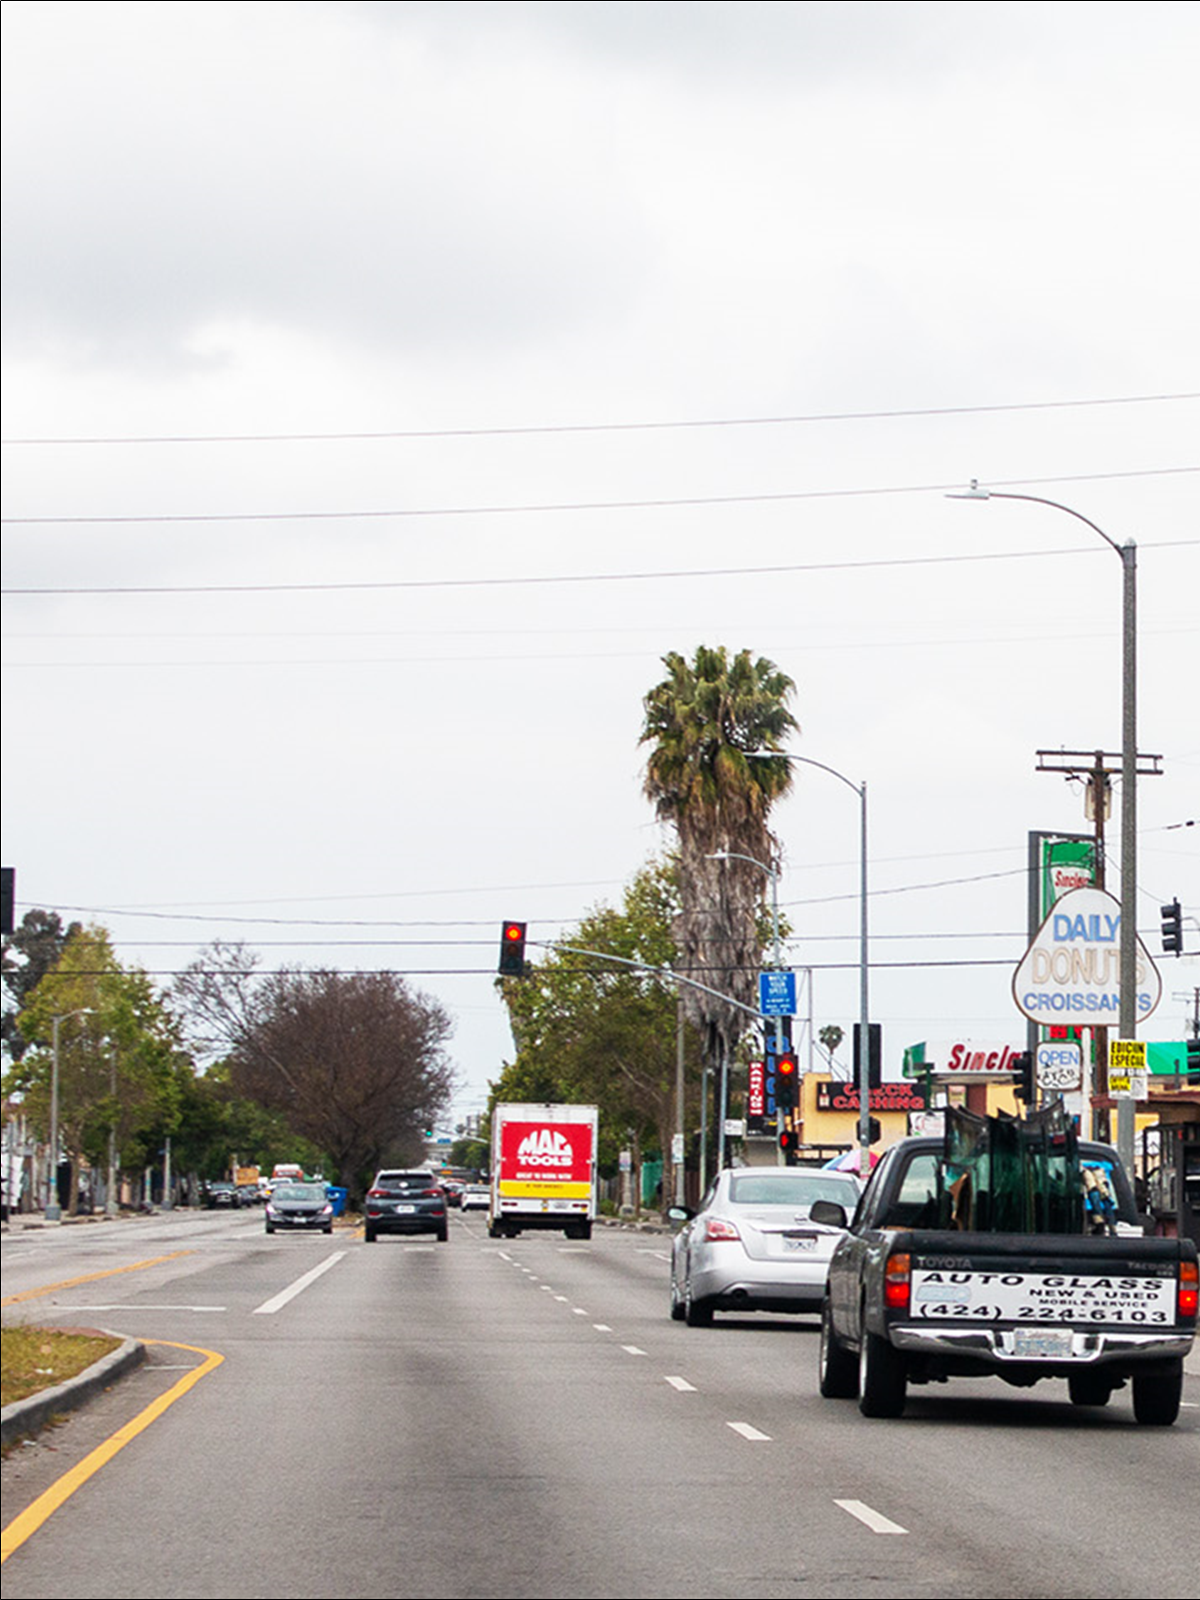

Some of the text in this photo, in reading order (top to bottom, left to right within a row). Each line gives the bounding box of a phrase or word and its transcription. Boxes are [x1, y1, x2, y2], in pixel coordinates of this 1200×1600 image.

[1053, 914, 1121, 942] DAILY
[1023, 992, 1152, 1012] CROISSANS
[1038, 1049, 1079, 1065] OPEN
[843, 1083, 914, 1097] CECK
[517, 1129, 573, 1156] MAC
[516, 1155, 573, 1167] TOOLS
[917, 1256, 973, 1270] TOYOTA
[922, 1272, 1164, 1291] AUTO GLASS
[1029, 1289, 1159, 1301] NEW & USED
[1039, 1299, 1149, 1308] MOBILE SERVICE
[920, 1303, 1168, 1324] (424) 224-6103
